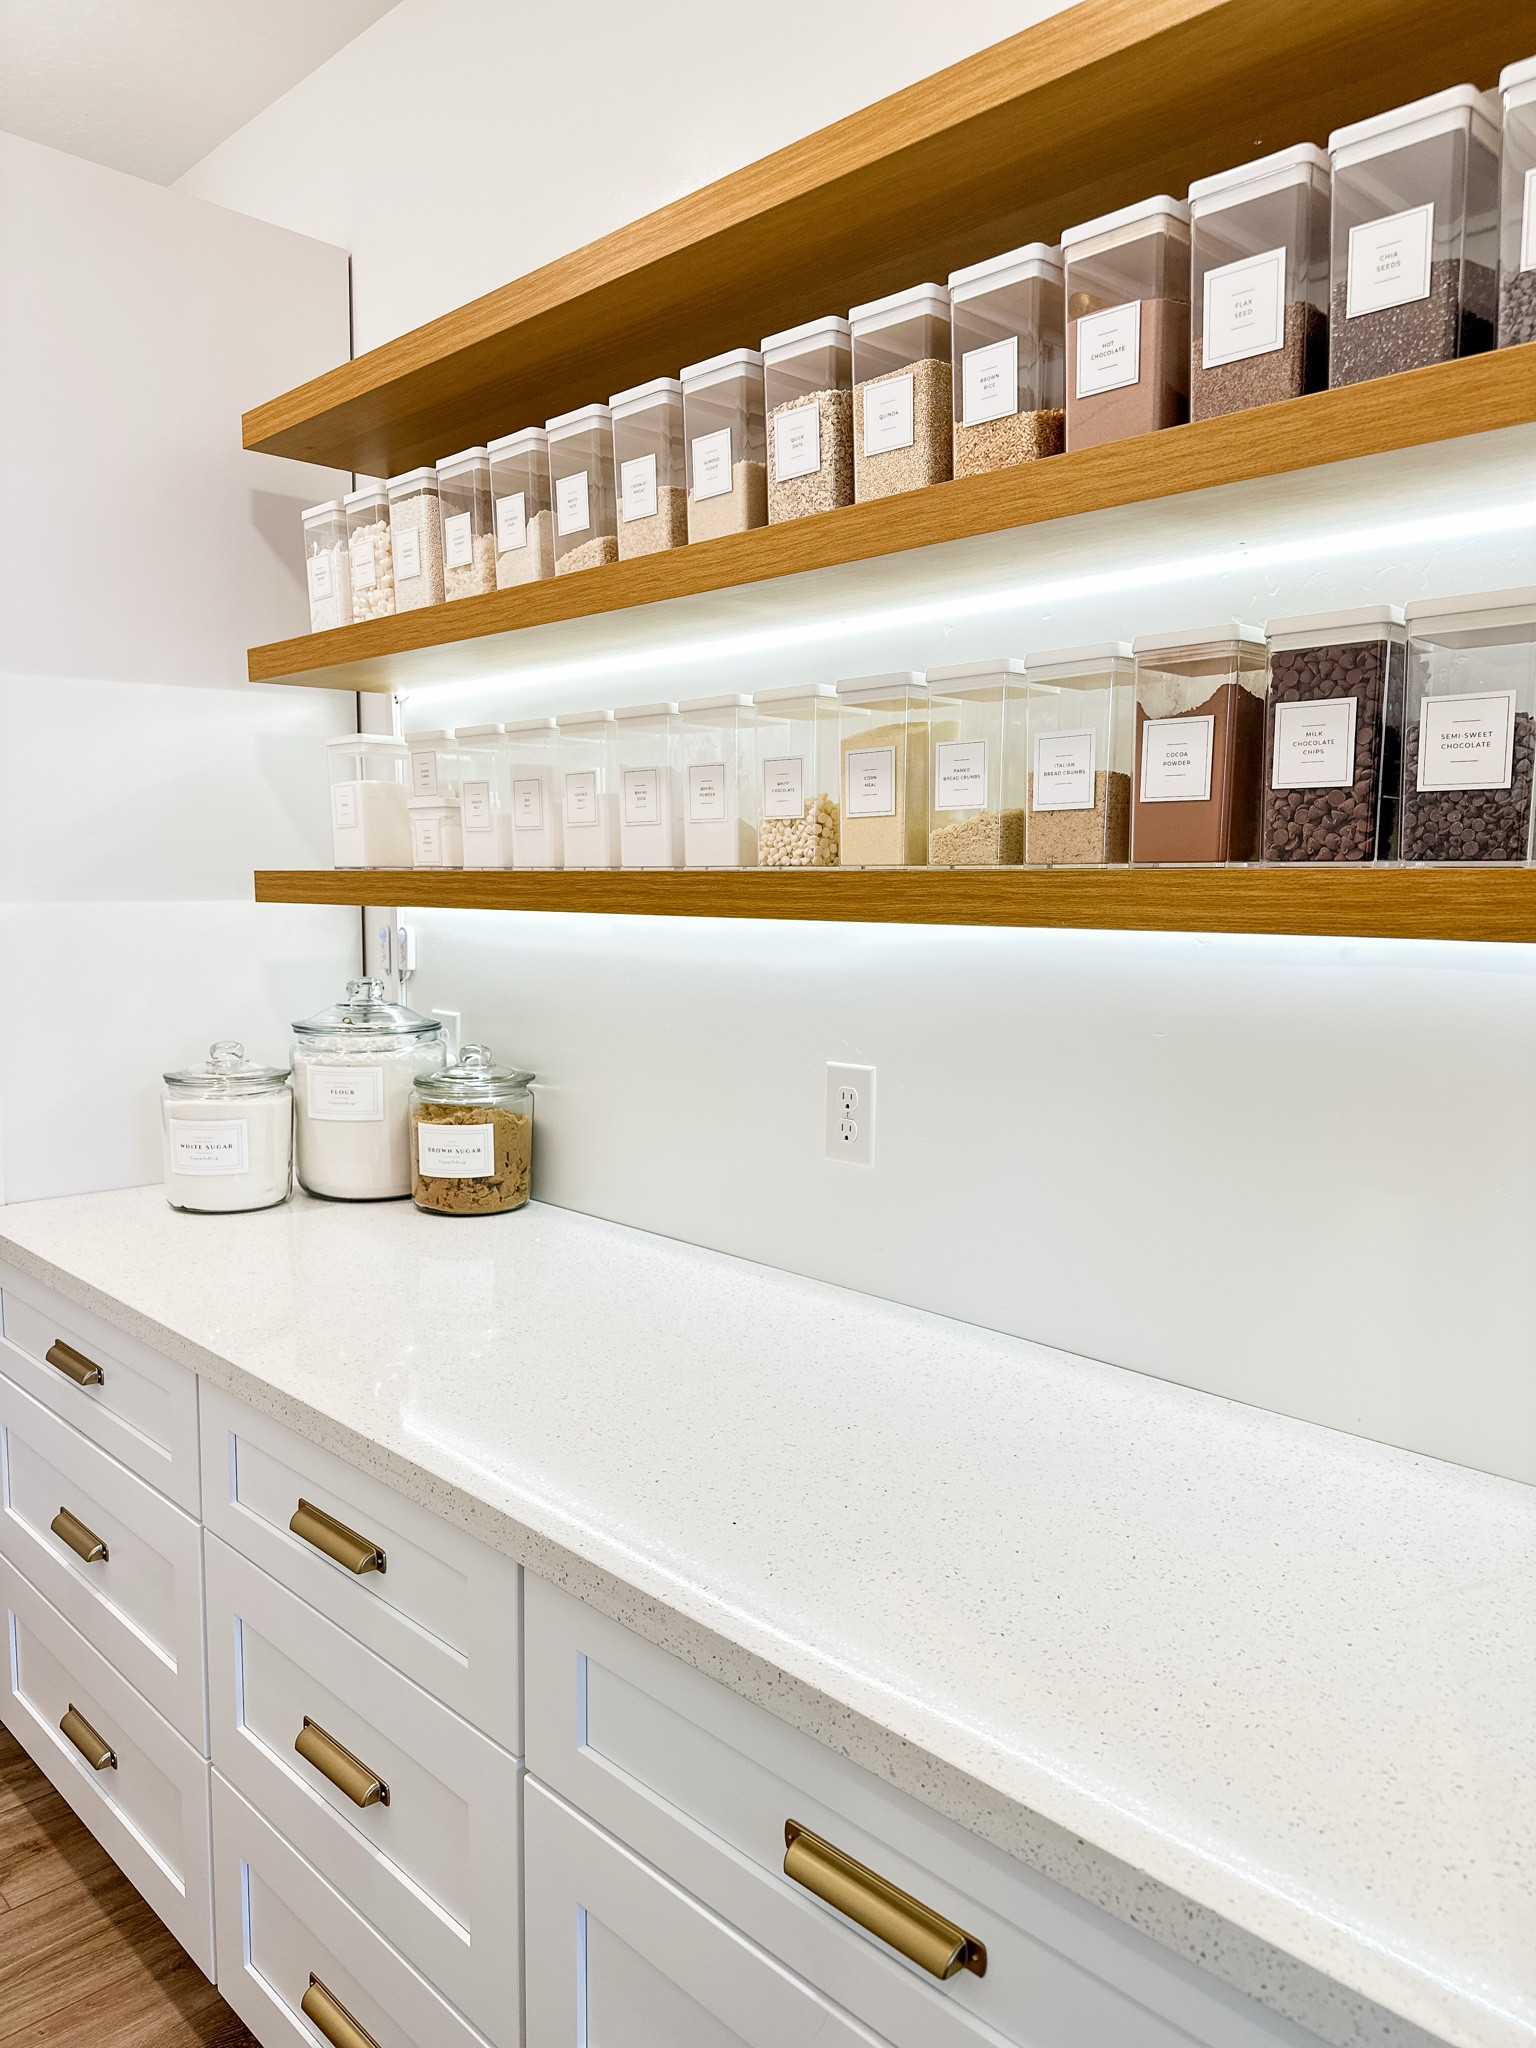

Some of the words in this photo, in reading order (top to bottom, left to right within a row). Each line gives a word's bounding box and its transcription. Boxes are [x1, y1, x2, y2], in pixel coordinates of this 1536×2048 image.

[1379, 251, 1399, 262] CHIA
[1376, 260, 1402, 273] SEEDS
[1235, 299, 1253, 309] FLAX
[1234, 308, 1253, 319] SEED
[1102, 340, 1115, 349] HOT
[1090, 345, 1126, 361] CHOCOLATE
[979, 373, 1000, 383] BROWN
[983, 382, 996, 390] RICE
[878, 410, 899, 420] QUINOA
[790, 435, 804, 443] QUICK
[703, 457, 720, 465] ALMOND
[1440, 731, 1494, 740] SEMI-SWEET
[1440, 741, 1492, 750] CHOCOLATE
